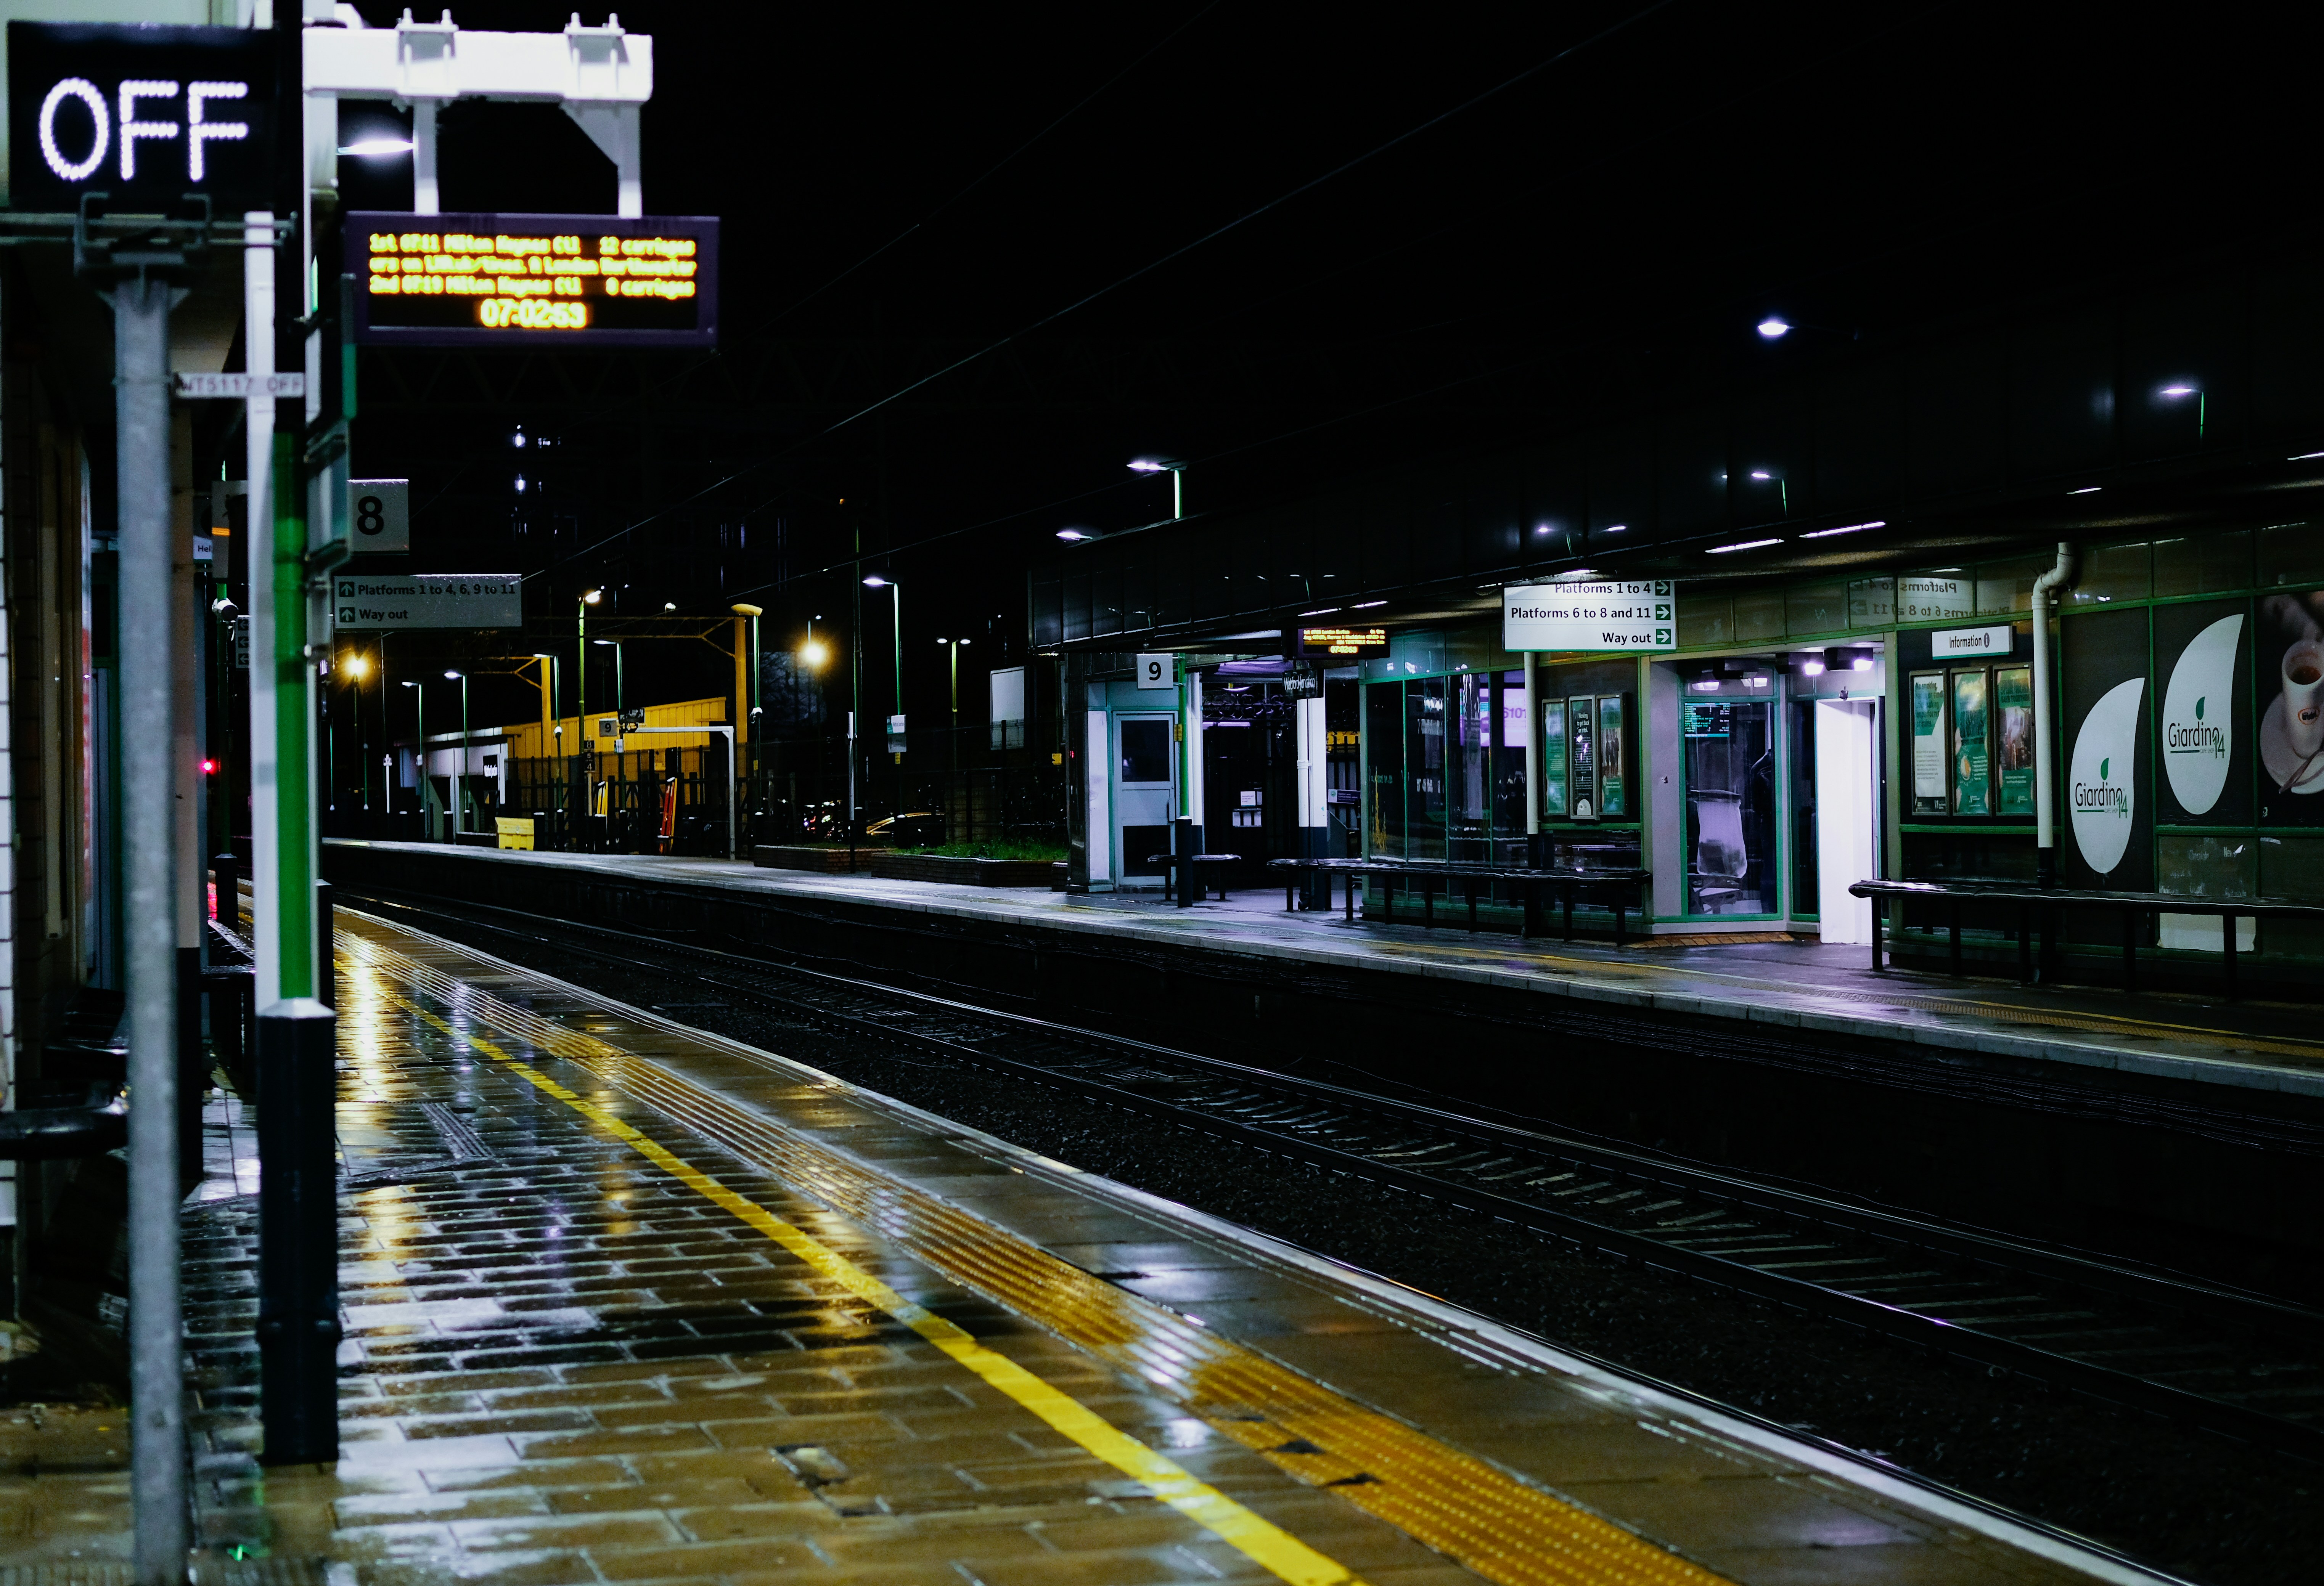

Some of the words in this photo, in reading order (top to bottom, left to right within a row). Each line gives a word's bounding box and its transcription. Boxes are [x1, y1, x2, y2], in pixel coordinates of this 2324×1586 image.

[39, 77, 249, 183] OFF
[444, 234, 495, 253] Milton
[621, 237, 696, 258] carriages
[543, 256, 599, 275] London
[446, 275, 495, 294] Milton
[620, 278, 695, 300] carriages
[357, 496, 384, 535] 8
[358, 585, 415, 595] Platforms
[419, 584, 426, 594] 1
[430, 585, 442, 594] to
[445, 584, 456, 596] 4,
[460, 584, 470, 596] 6,
[474, 584, 481, 594] 9
[485, 585, 497, 594] to
[501, 584, 516, 594] 11
[1555, 583, 1613, 594] Platforms
[1617, 583, 1623, 593] 1
[1628, 584, 1639, 594] to
[1643, 583, 1651, 593] 4
[359, 610, 384, 621] Way
[387, 610, 408, 619] out
[1511, 607, 1569, 618] Platforms
[1573, 607, 1580, 618] 6
[1584, 608, 1596, 618] to
[1600, 607, 1607, 618] 8
[1611, 607, 1632, 618] and
[1636, 607, 1651, 618] 11
[1602, 632, 1628, 645] Way
[1631, 633, 1651, 643] out
[1949, 635, 1982, 649] Information
[1149, 661, 1161, 681] 9
[1284, 675, 1299, 690] Watford
[1299, 674, 1315, 692] Junction
[605, 723, 611, 732] 9
[2168, 721, 2220, 747] Giardino
[2213, 734, 2225, 758] 14
[2075, 782, 2123, 806] Giardino
[2117, 794, 2128, 818] 14
